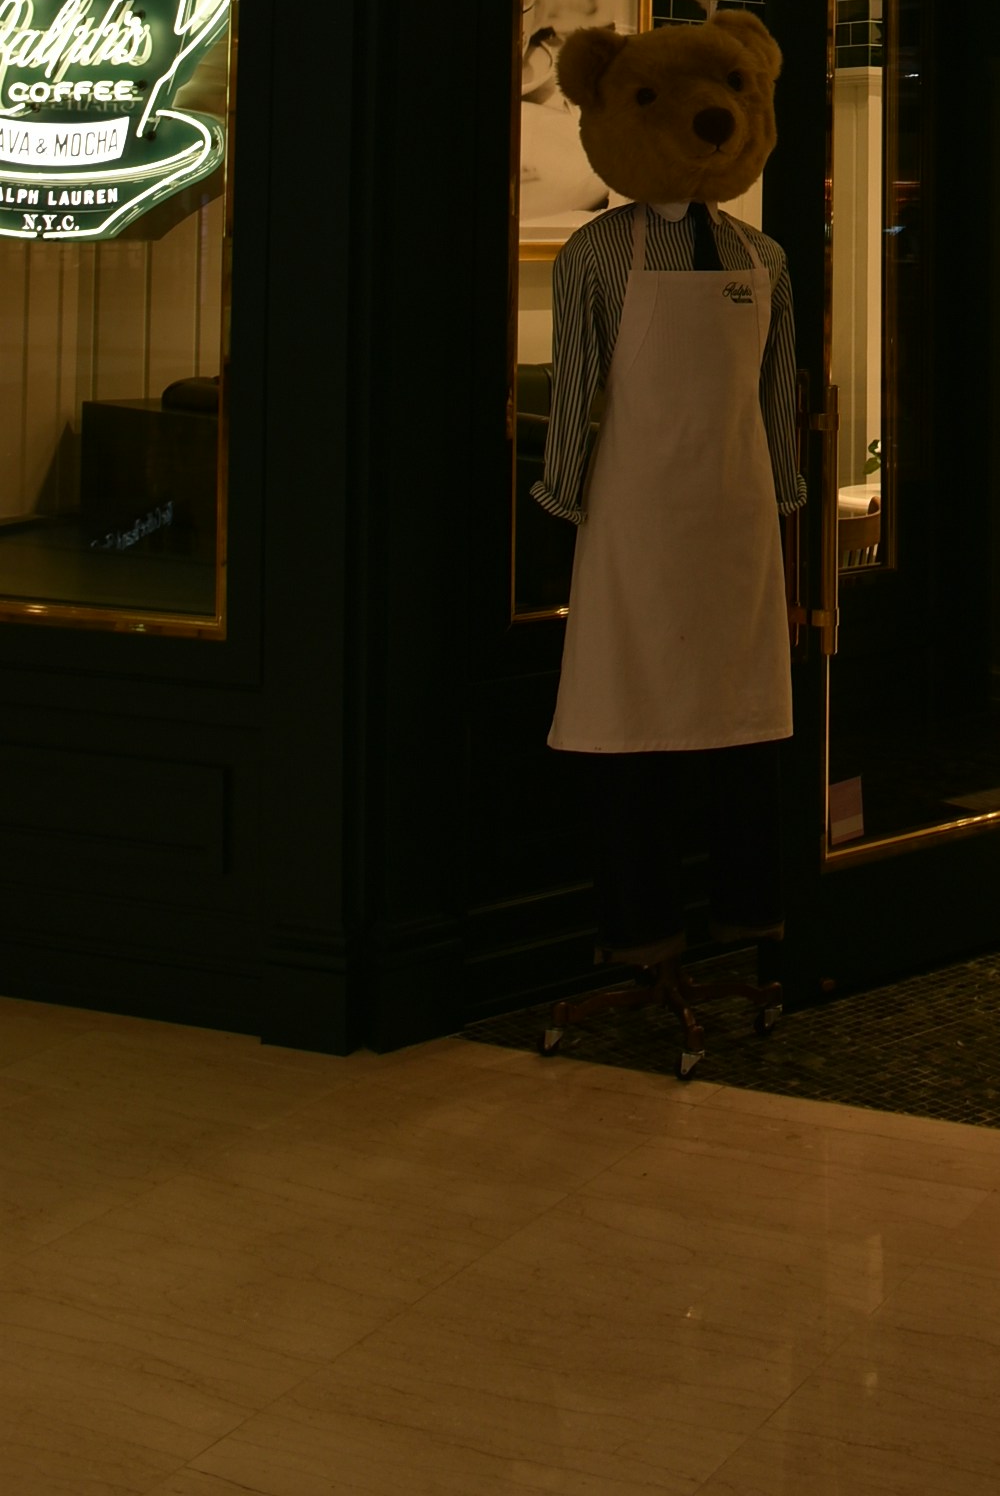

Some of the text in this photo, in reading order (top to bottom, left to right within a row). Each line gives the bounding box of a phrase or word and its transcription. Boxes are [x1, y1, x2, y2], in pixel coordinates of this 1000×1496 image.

[8, 80, 135, 102] COFFEE
[54, 129, 118, 157] MOCHA
[48, 187, 119, 206] LAUREN
[22, 214, 80, 231] N.Y.C.
